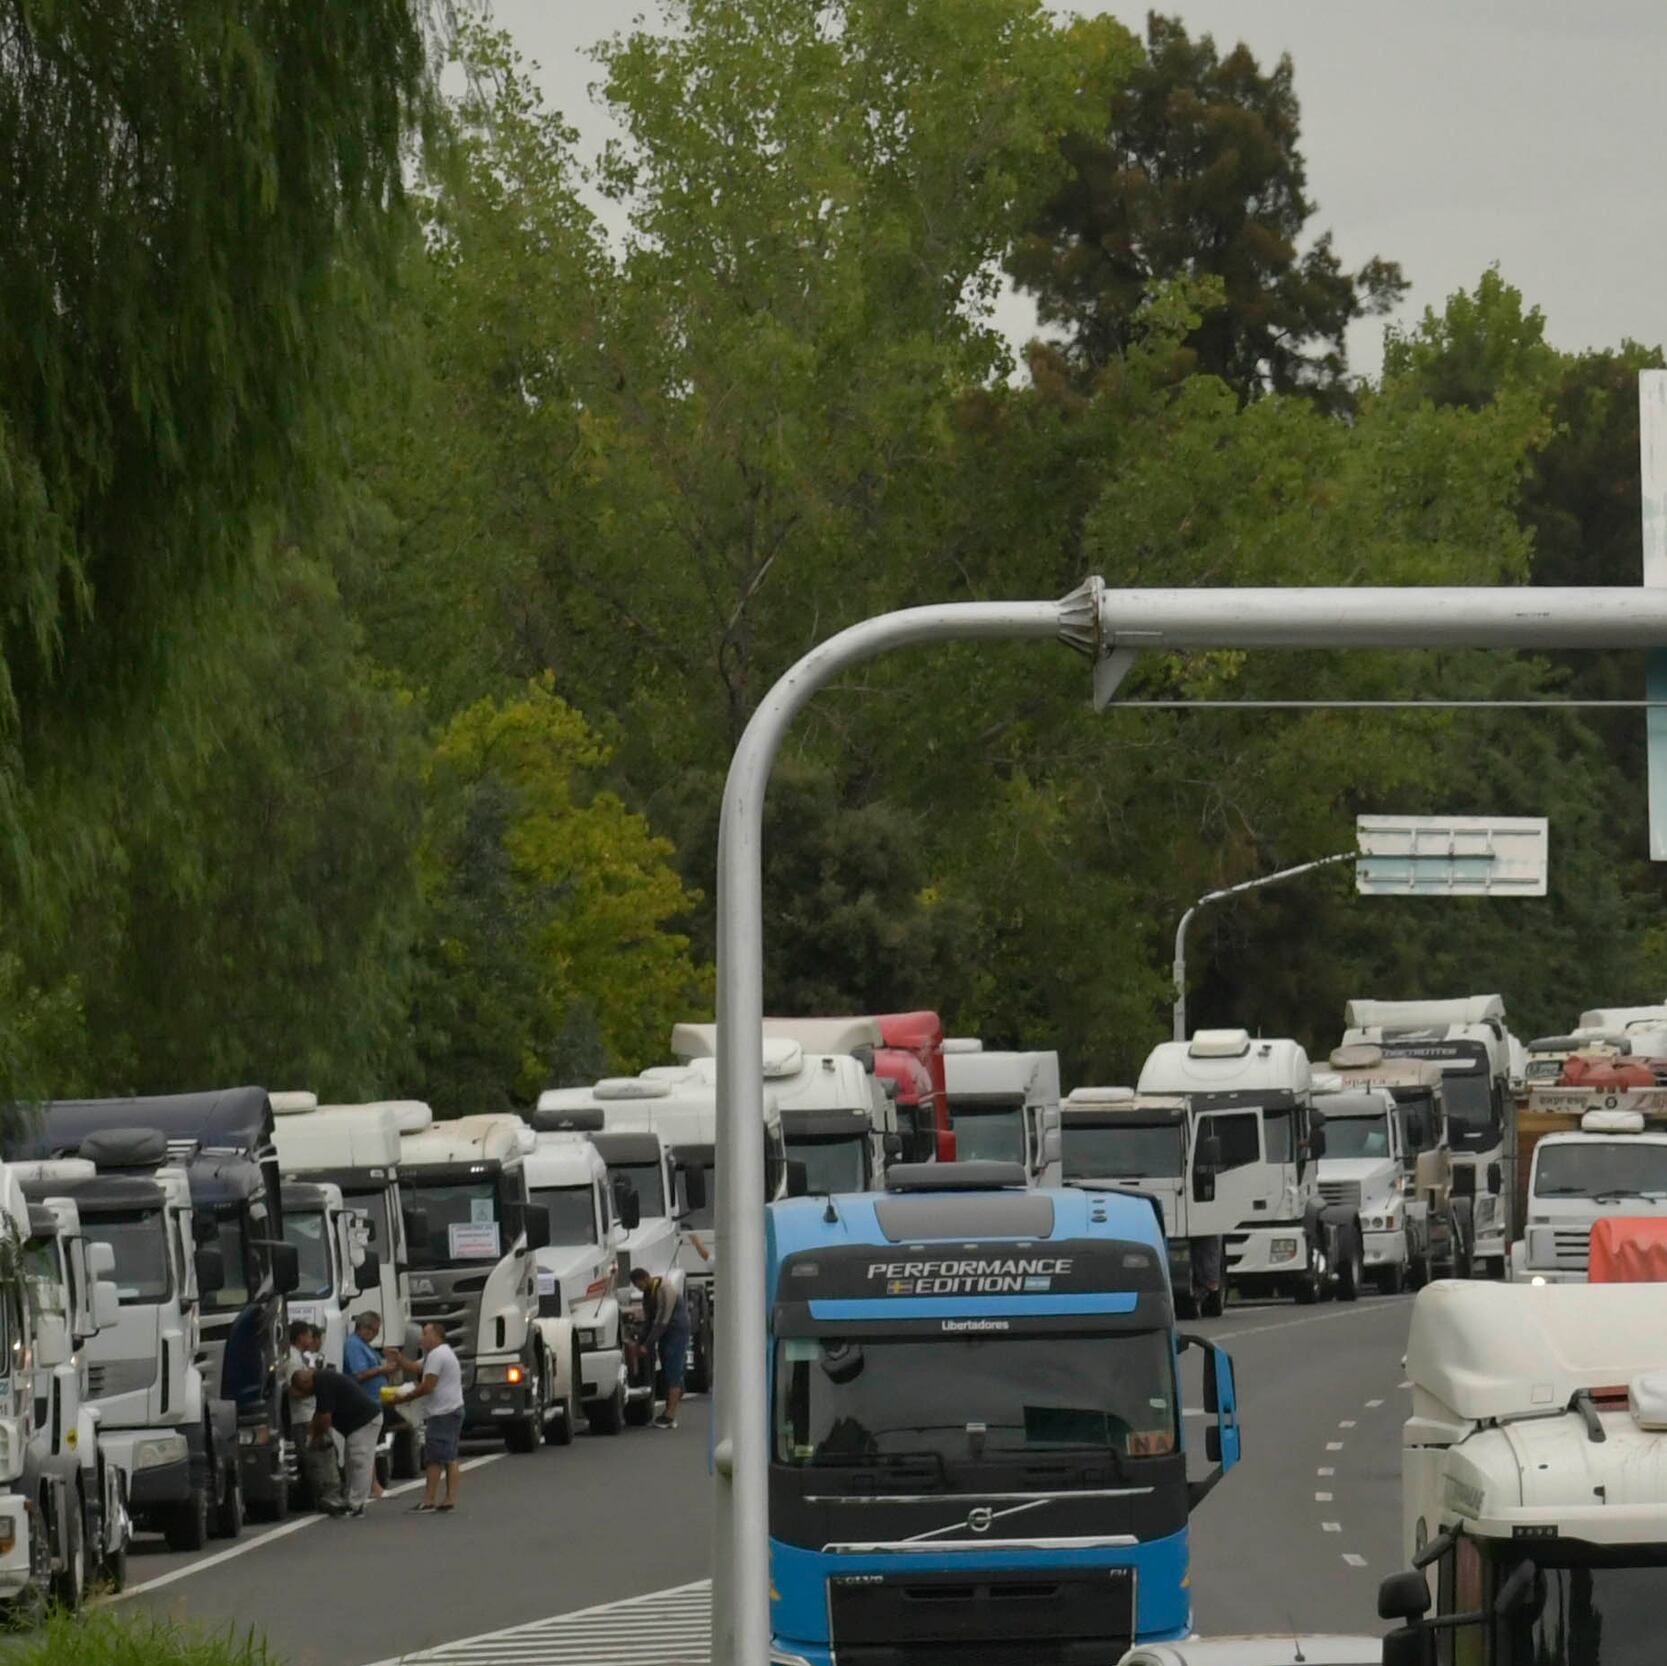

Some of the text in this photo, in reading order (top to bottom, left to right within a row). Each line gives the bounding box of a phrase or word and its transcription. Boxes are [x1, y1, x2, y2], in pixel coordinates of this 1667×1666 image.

[867, 1259, 1074, 1279] PERFORMANCE
[915, 1276, 1023, 1294] EDITION
[941, 1320, 1010, 1331] Libertadores
